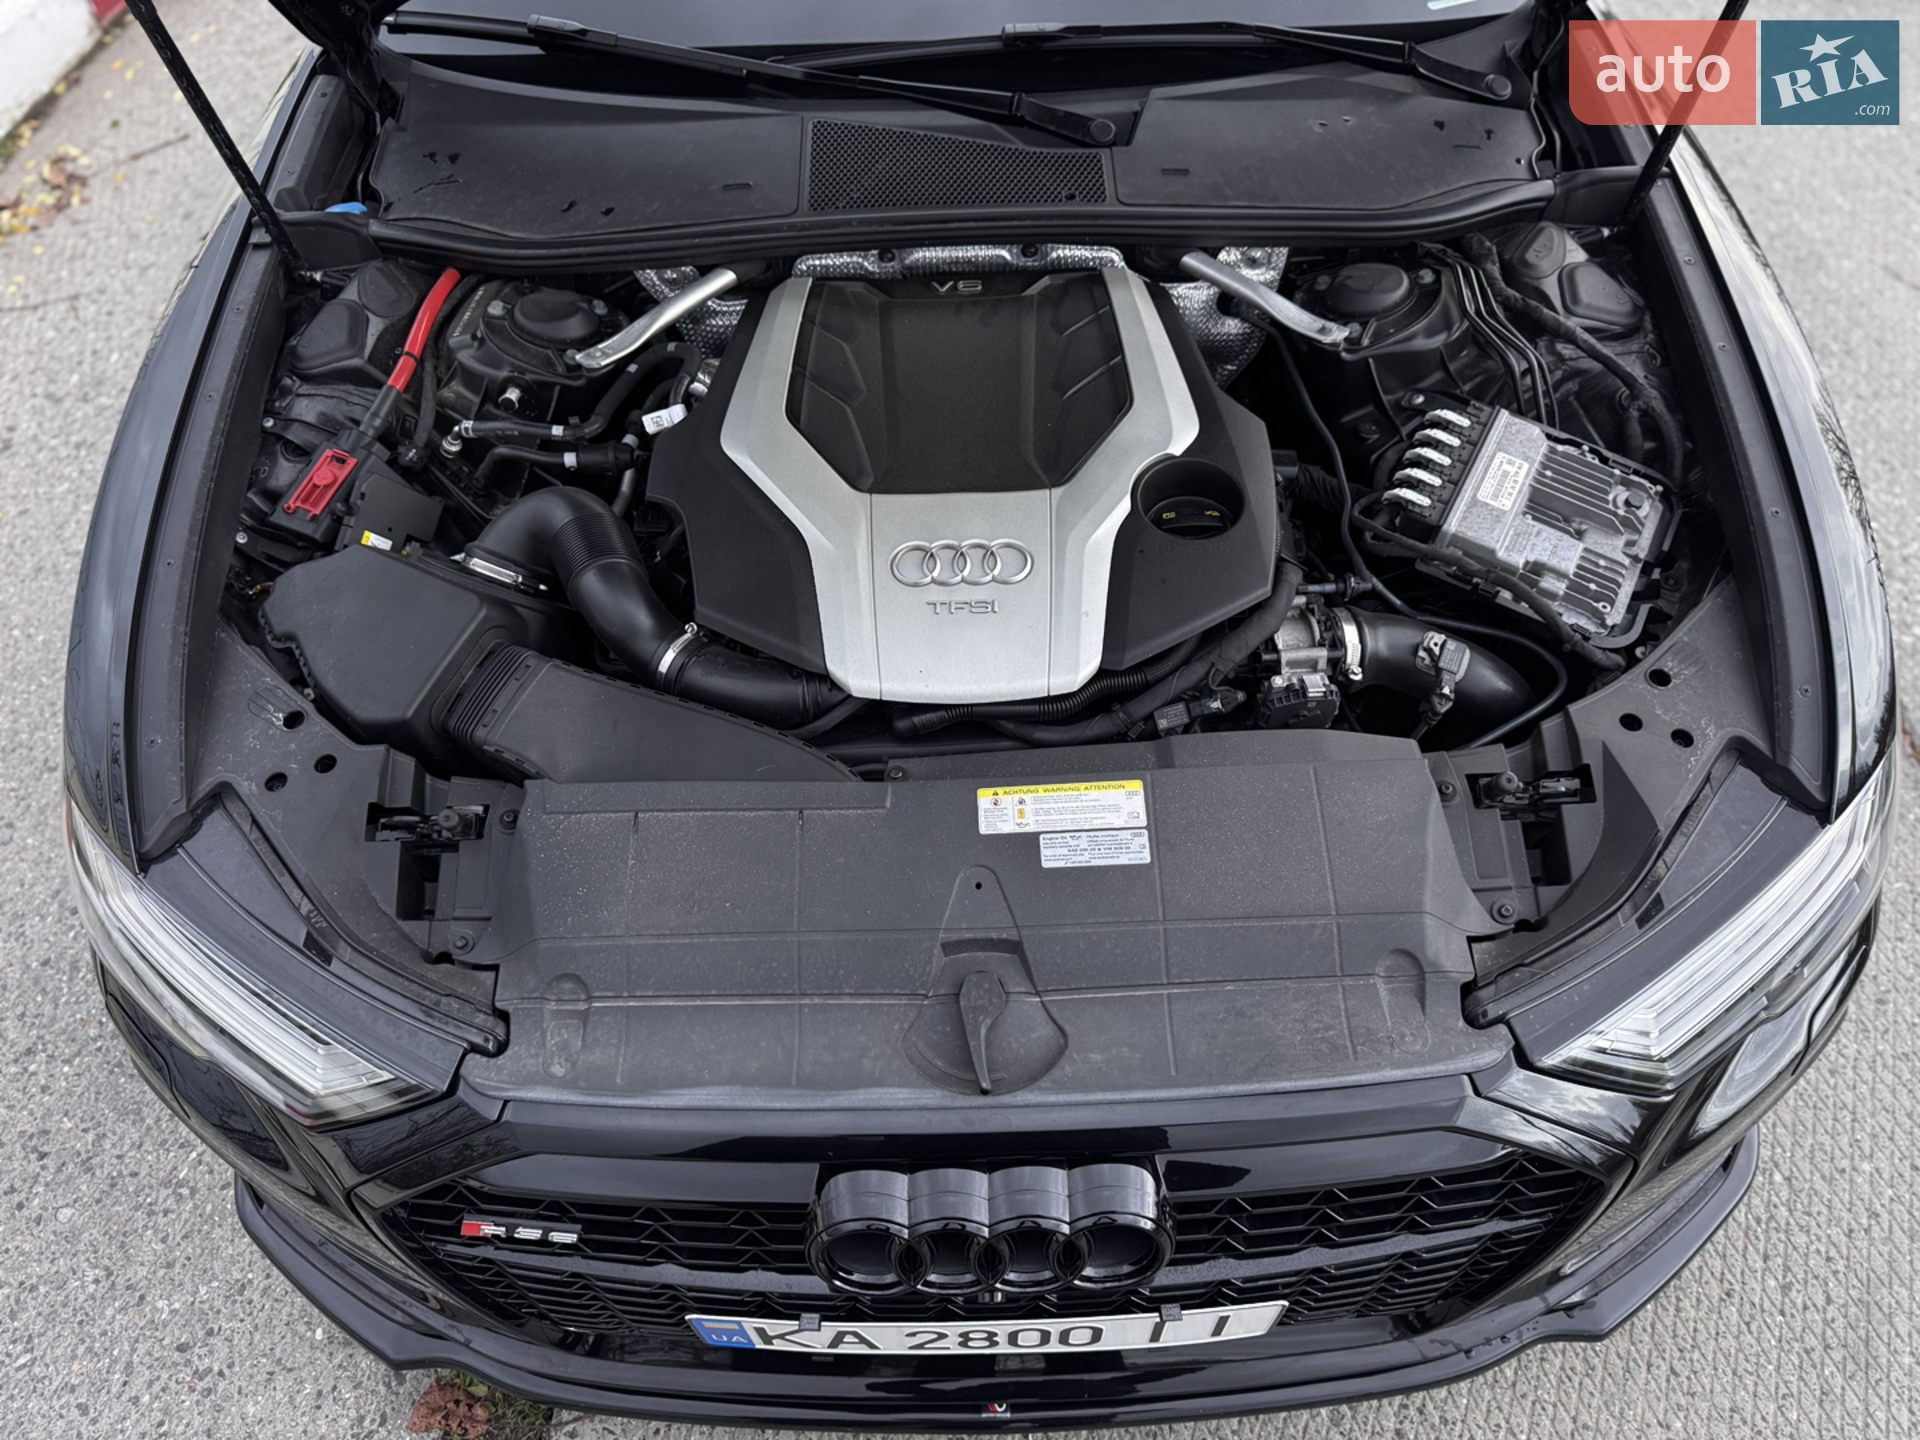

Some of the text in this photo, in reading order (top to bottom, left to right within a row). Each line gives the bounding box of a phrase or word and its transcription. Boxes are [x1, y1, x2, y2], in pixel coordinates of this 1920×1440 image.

[931, 280, 982, 292] V6
[926, 599, 999, 615] TFSI
[1002, 788, 1039, 796] ACHTUNG
[711, 1333, 748, 1343] UA
[753, 1326, 882, 1349] KA
[904, 1325, 1104, 1349] 2800
